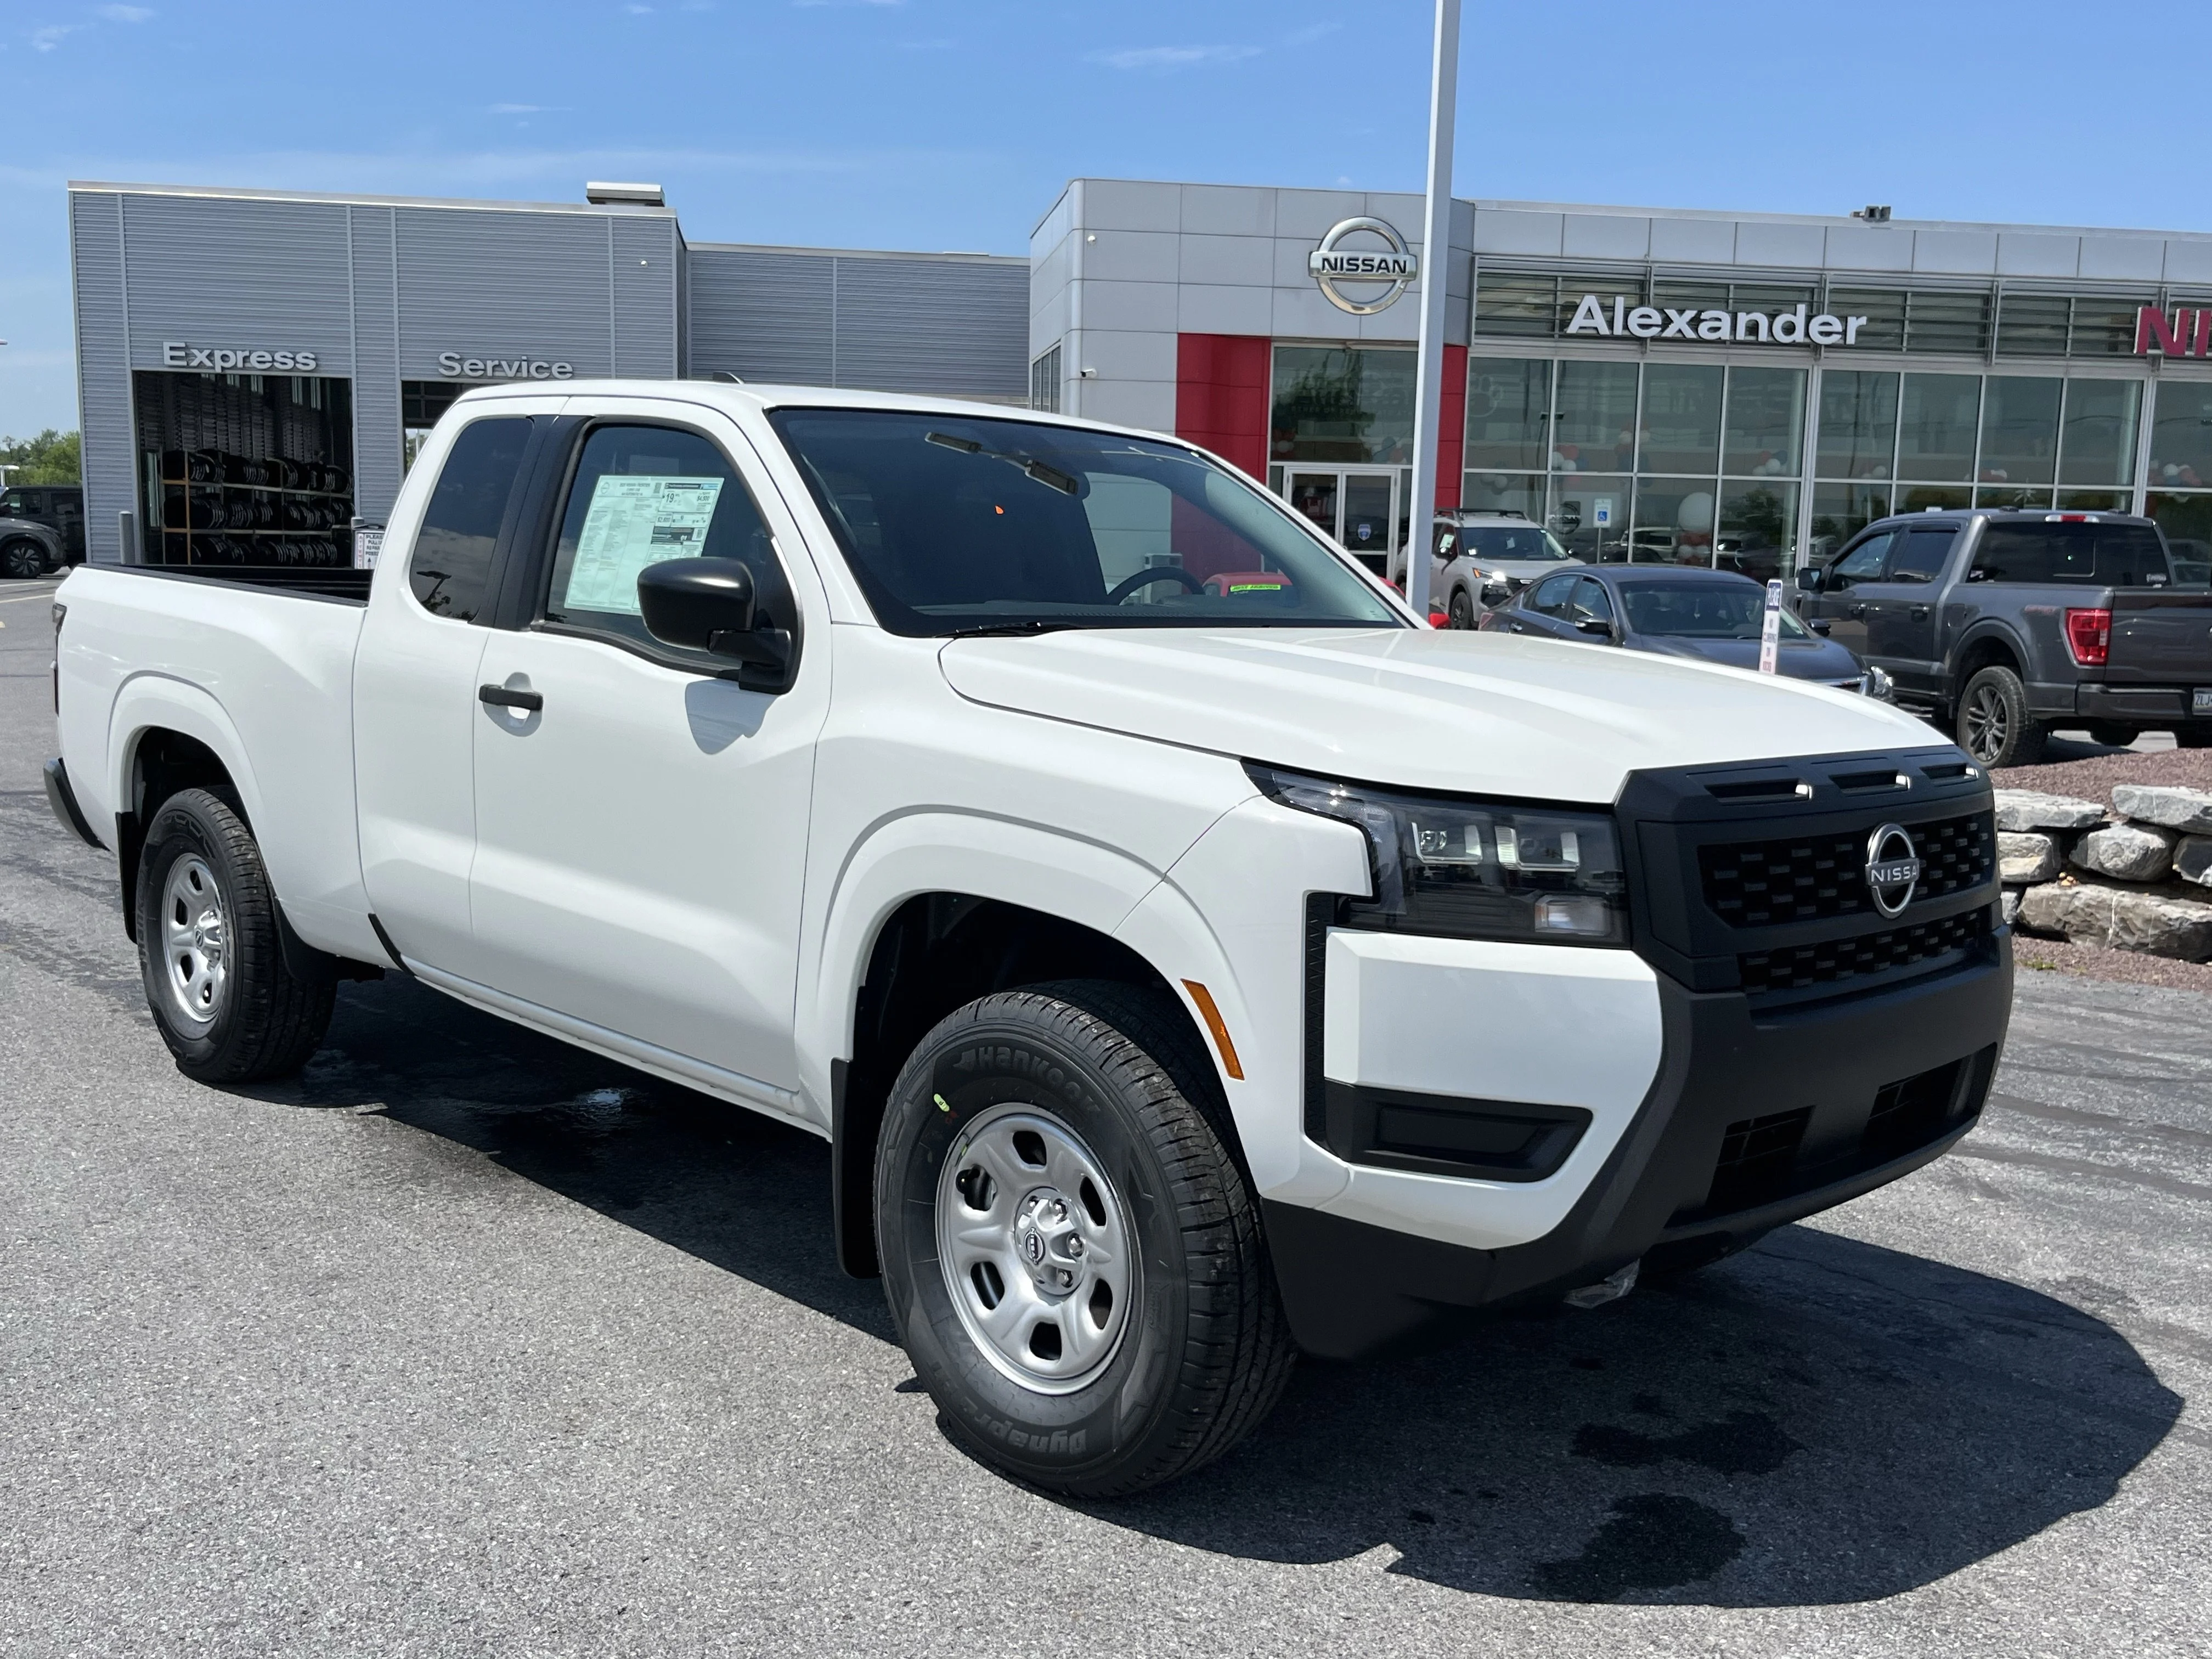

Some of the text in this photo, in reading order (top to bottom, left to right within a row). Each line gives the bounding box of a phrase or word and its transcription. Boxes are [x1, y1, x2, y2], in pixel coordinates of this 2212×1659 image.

[1322, 257, 1407, 273] NISSAN
[1566, 295, 1867, 345] Alexander
[2134, 306, 2212, 356] NI
[163, 342, 317, 373] Express
[439, 352, 573, 379] Service
[2196, 695, 2212, 706] ZLJ
[1871, 865, 1918, 882] NISSA
